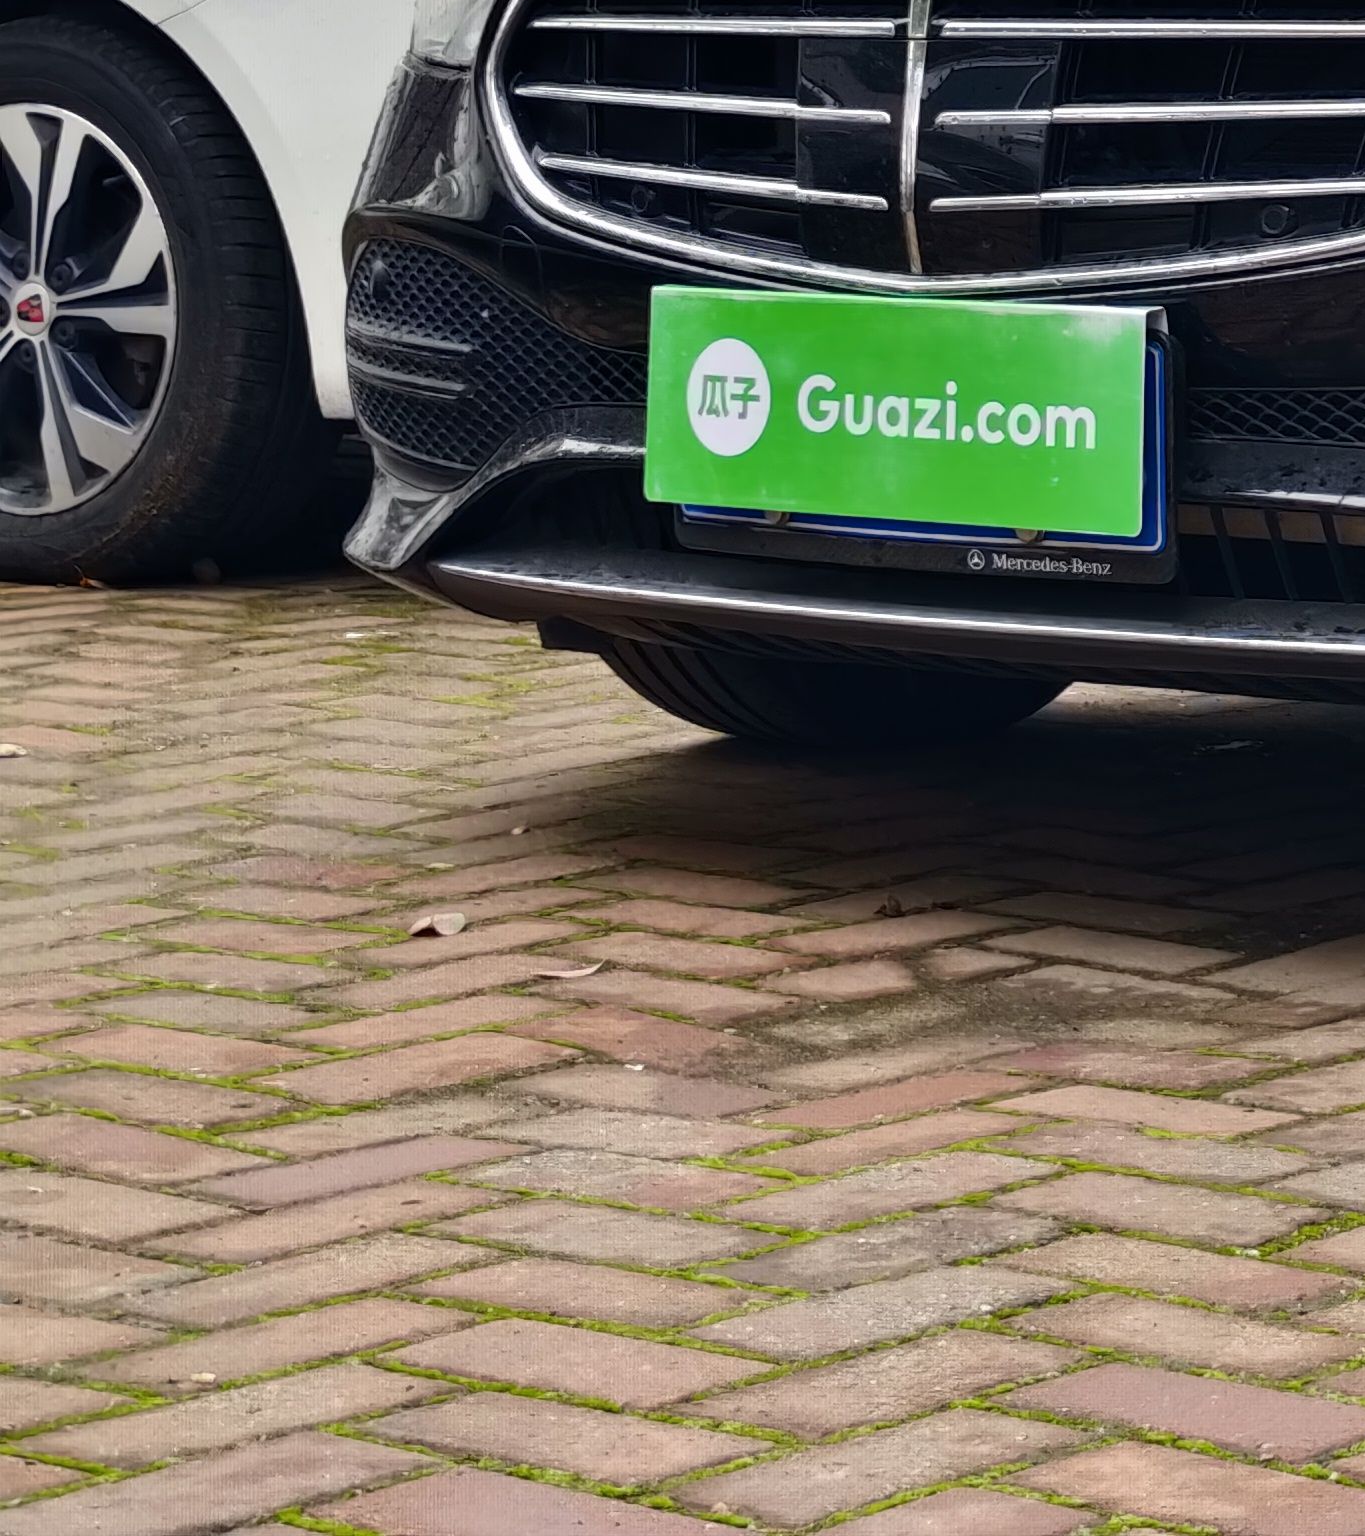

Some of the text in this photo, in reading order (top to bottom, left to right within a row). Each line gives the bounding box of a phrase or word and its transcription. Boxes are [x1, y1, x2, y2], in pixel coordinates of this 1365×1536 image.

[698, 375, 761, 419] 瓜子
[798, 374, 1097, 449] Guazi.com
[992, 553, 1112, 576] Mercedes-Benz
